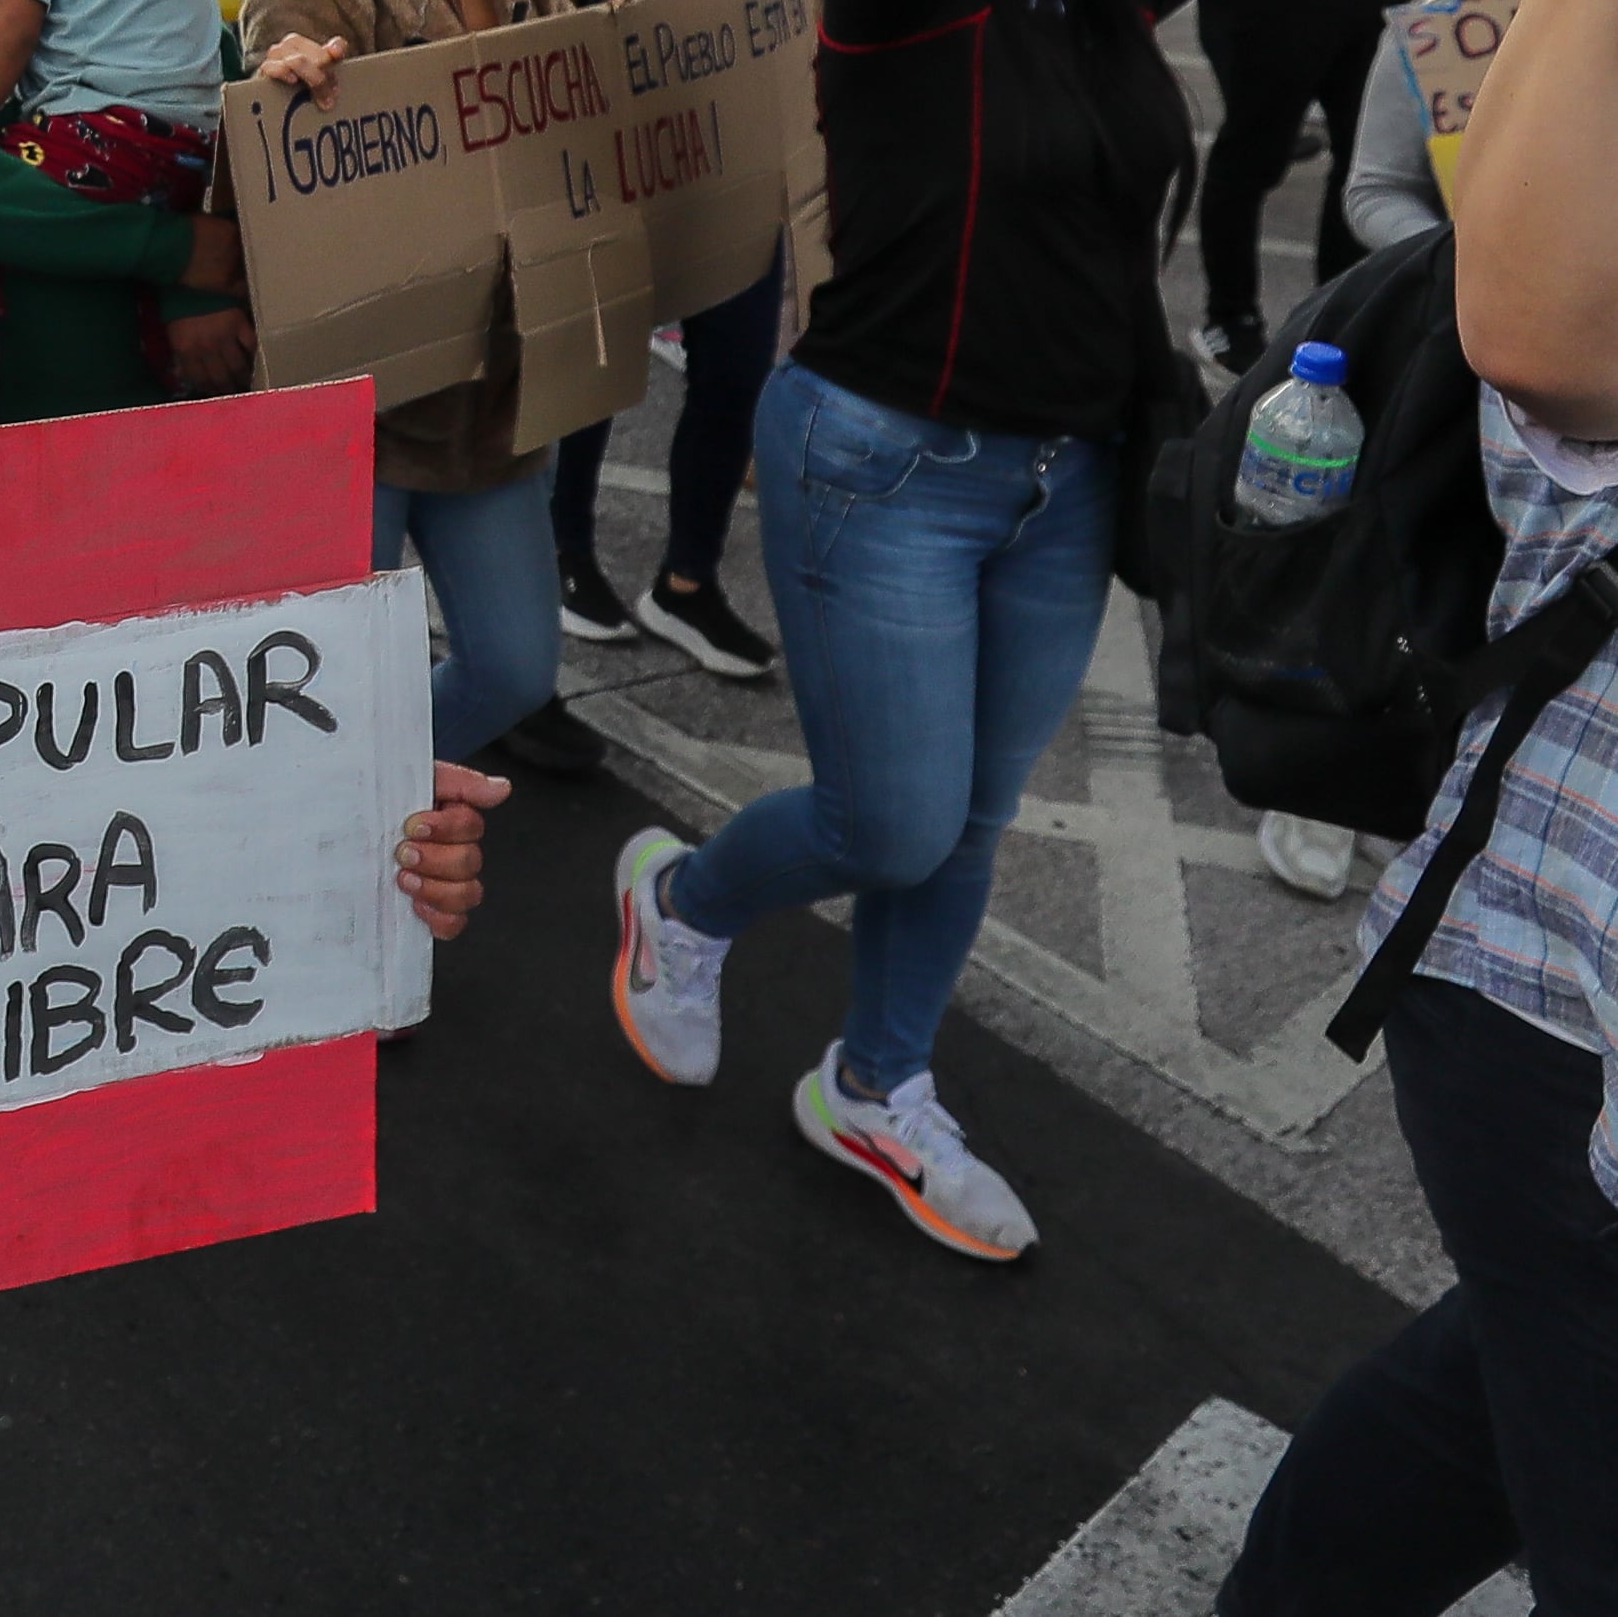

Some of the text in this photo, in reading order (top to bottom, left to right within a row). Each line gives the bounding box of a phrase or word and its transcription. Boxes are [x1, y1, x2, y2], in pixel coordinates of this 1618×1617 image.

[622, 34, 659, 97] EL
[658, 22, 736, 86] PUEBLO
[564, 99, 725, 220] LA LUCHA!
